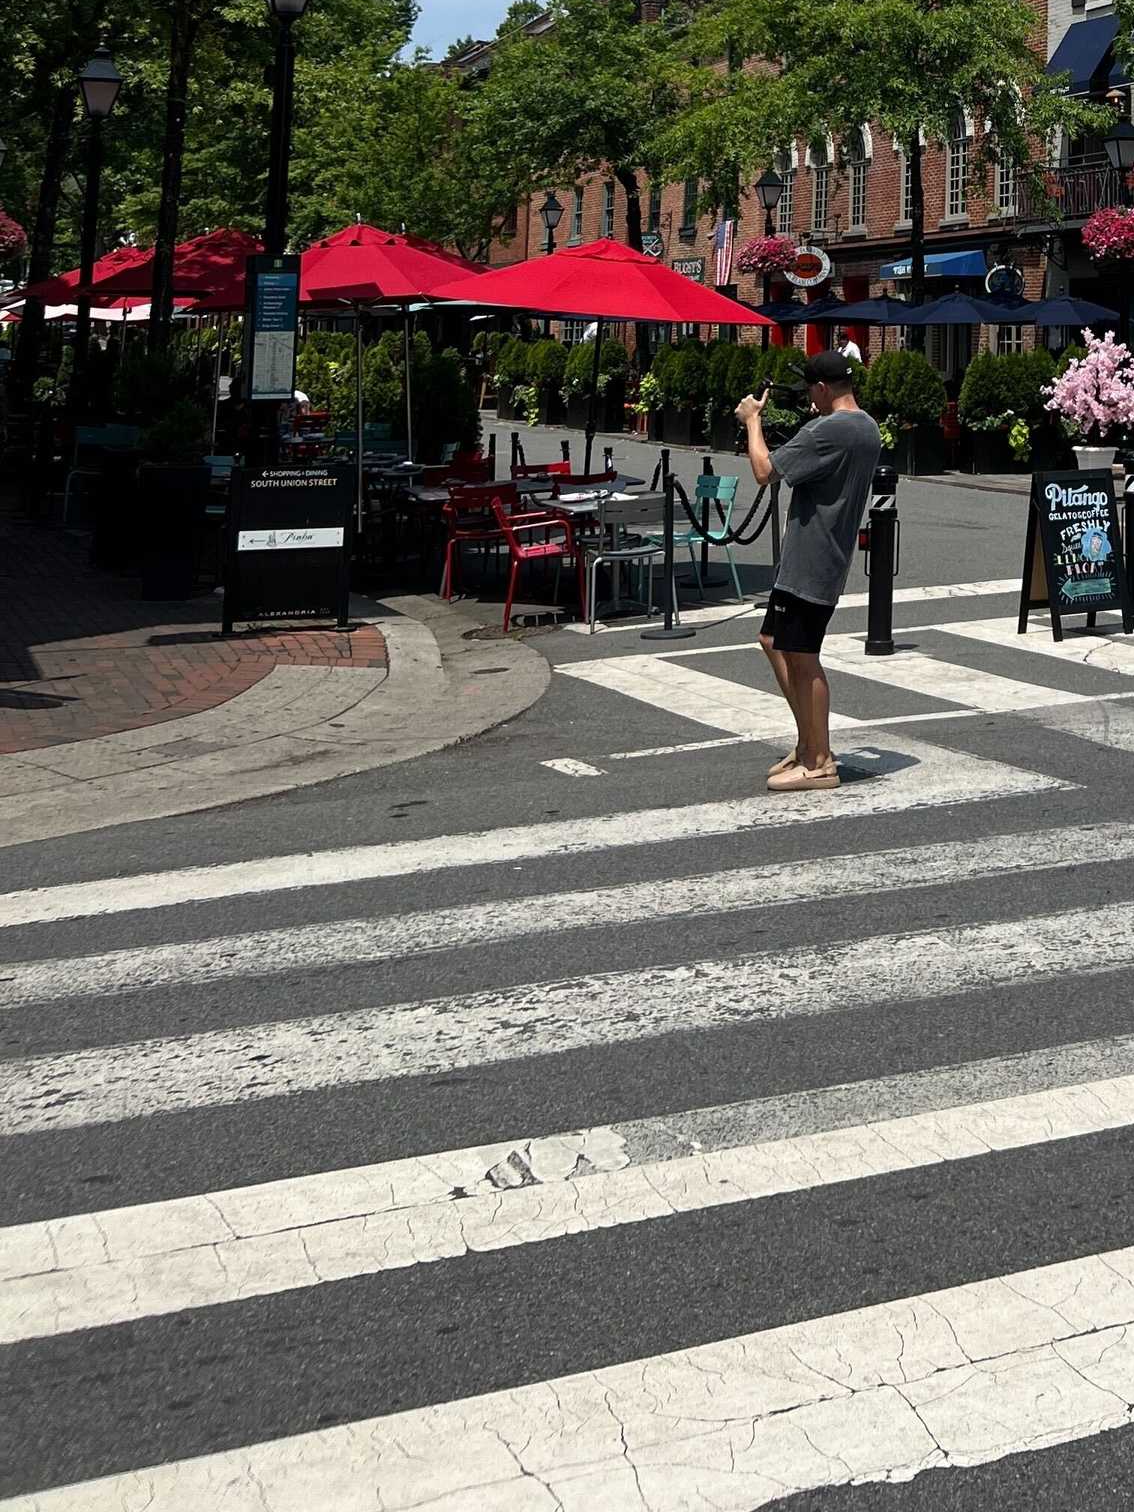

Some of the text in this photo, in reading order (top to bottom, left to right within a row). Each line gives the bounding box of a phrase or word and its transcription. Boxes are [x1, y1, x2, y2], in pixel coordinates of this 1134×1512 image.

[251, 478, 338, 488] SOUTH UNION STREET
[1045, 483, 1108, 511] Pitango
[1060, 519, 1111, 541] FRESHLY
[258, 609, 316, 617] ALEXANDRIA
